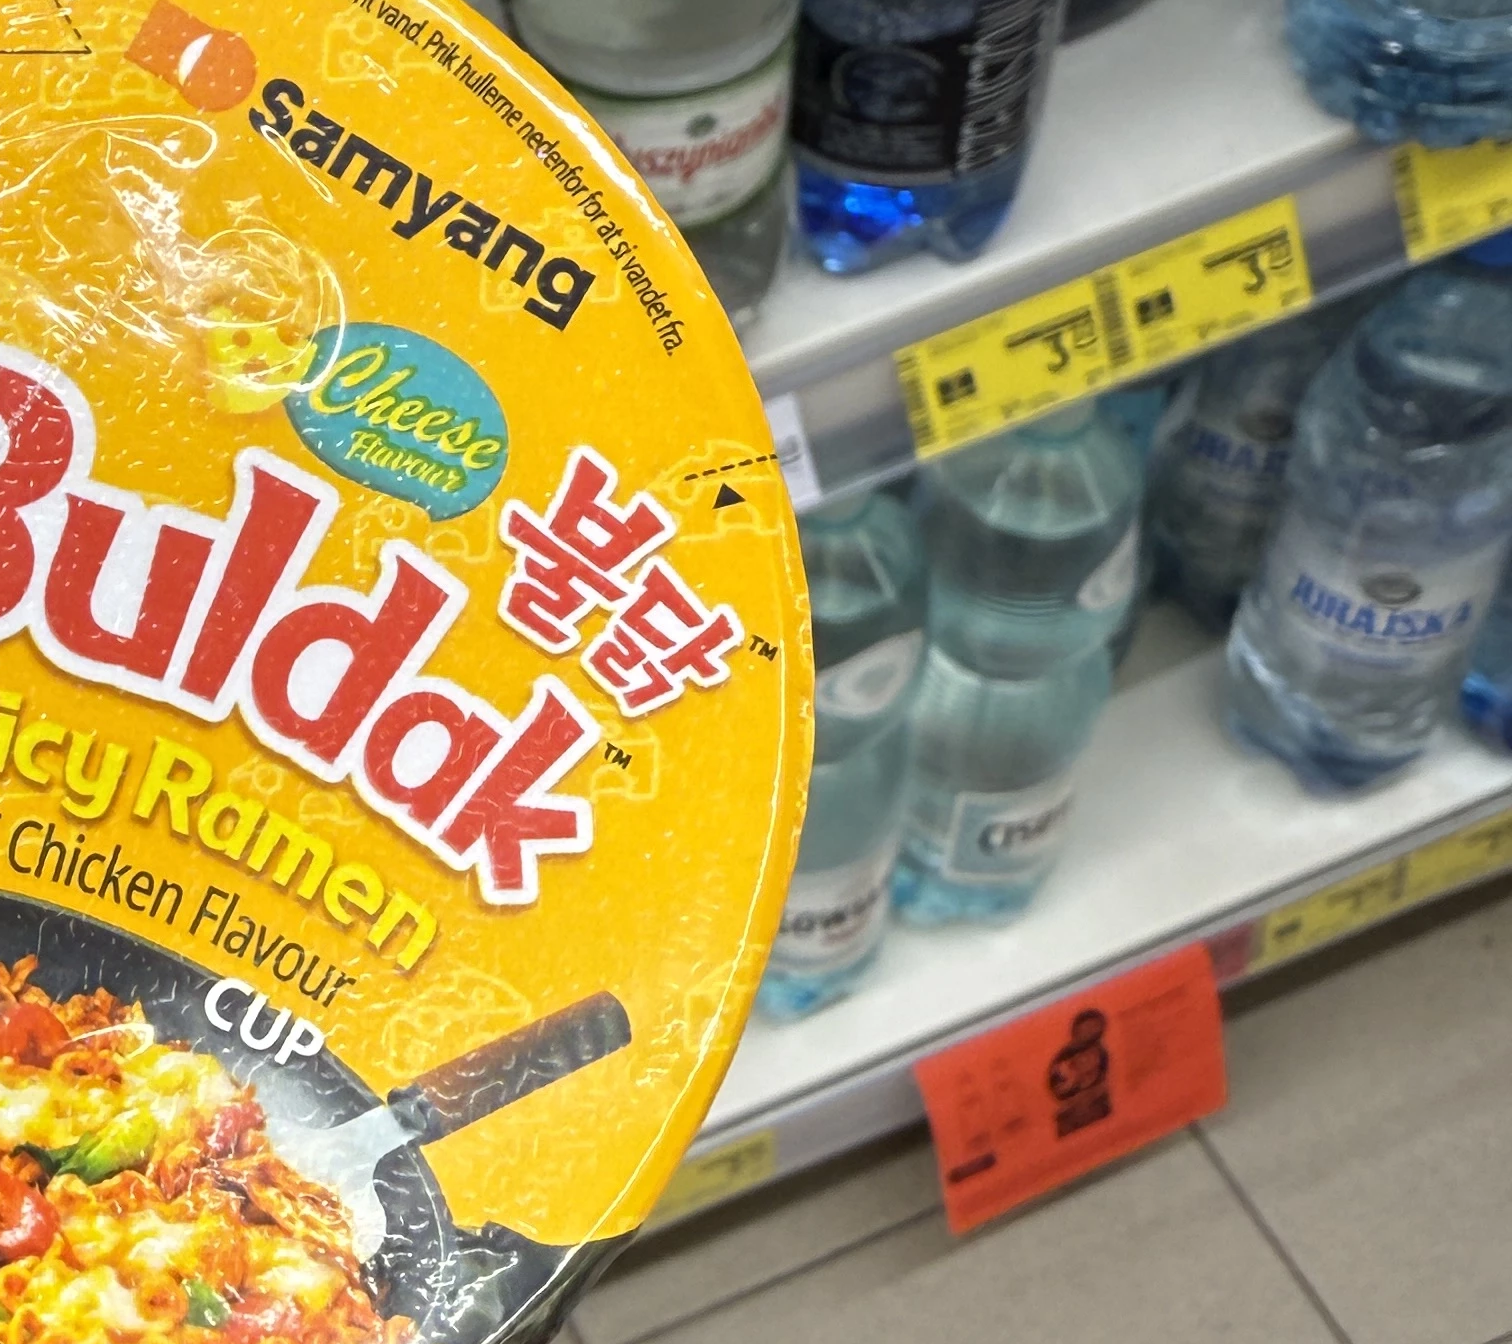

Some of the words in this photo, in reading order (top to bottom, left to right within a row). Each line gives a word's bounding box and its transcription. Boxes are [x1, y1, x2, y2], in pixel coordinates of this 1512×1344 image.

[377, 0, 430, 47] vand.
[421, 30, 462, 73] Prik
[453, 55, 523, 128] hullerne
[517, 120, 589, 197] nedenfor
[248, 78, 596, 332] samyang
[578, 190, 609, 224] for
[597, 220, 623, 246] at
[609, 238, 638, 259] si
[621, 255, 672, 326] vandet
[657, 320, 685, 357] fra.
[308, 343, 503, 472] Cheese
[345, 430, 467, 493] Flavour
[504, 450, 738, 713] 불닭
[132, 736, 438, 971] Ramen
[8, 820, 185, 926] Chicken
[188, 885, 357, 1009] Flavour
[203, 977, 326, 1067] CUP
